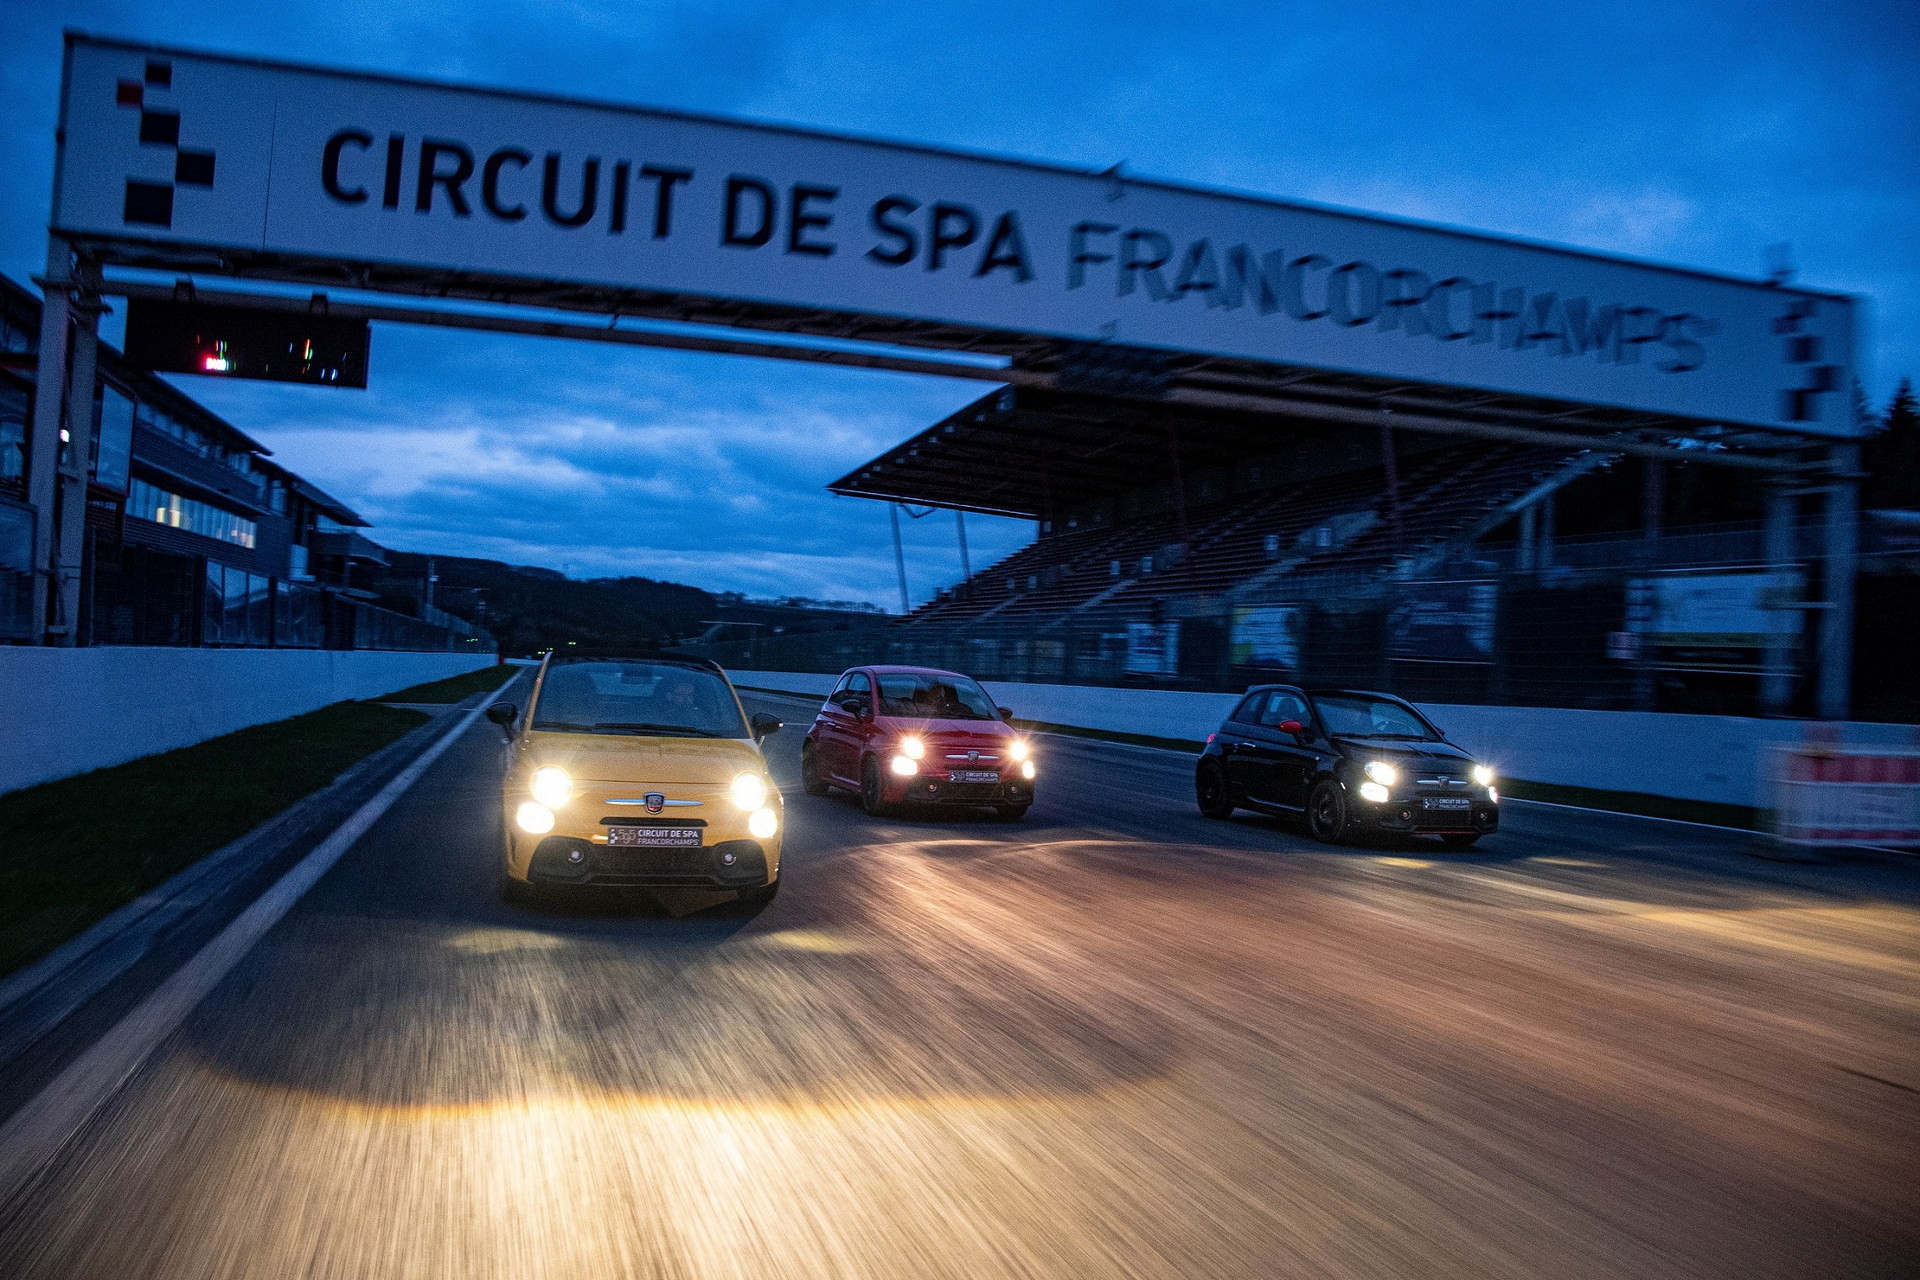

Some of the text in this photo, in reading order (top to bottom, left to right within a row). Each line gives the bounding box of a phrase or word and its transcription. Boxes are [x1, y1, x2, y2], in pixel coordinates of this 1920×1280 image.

[321, 127, 1706, 374] CIRCUIT DE SPA FRANCORCHAMPS
[638, 829, 698, 838] CIRCUIT DE SPA
